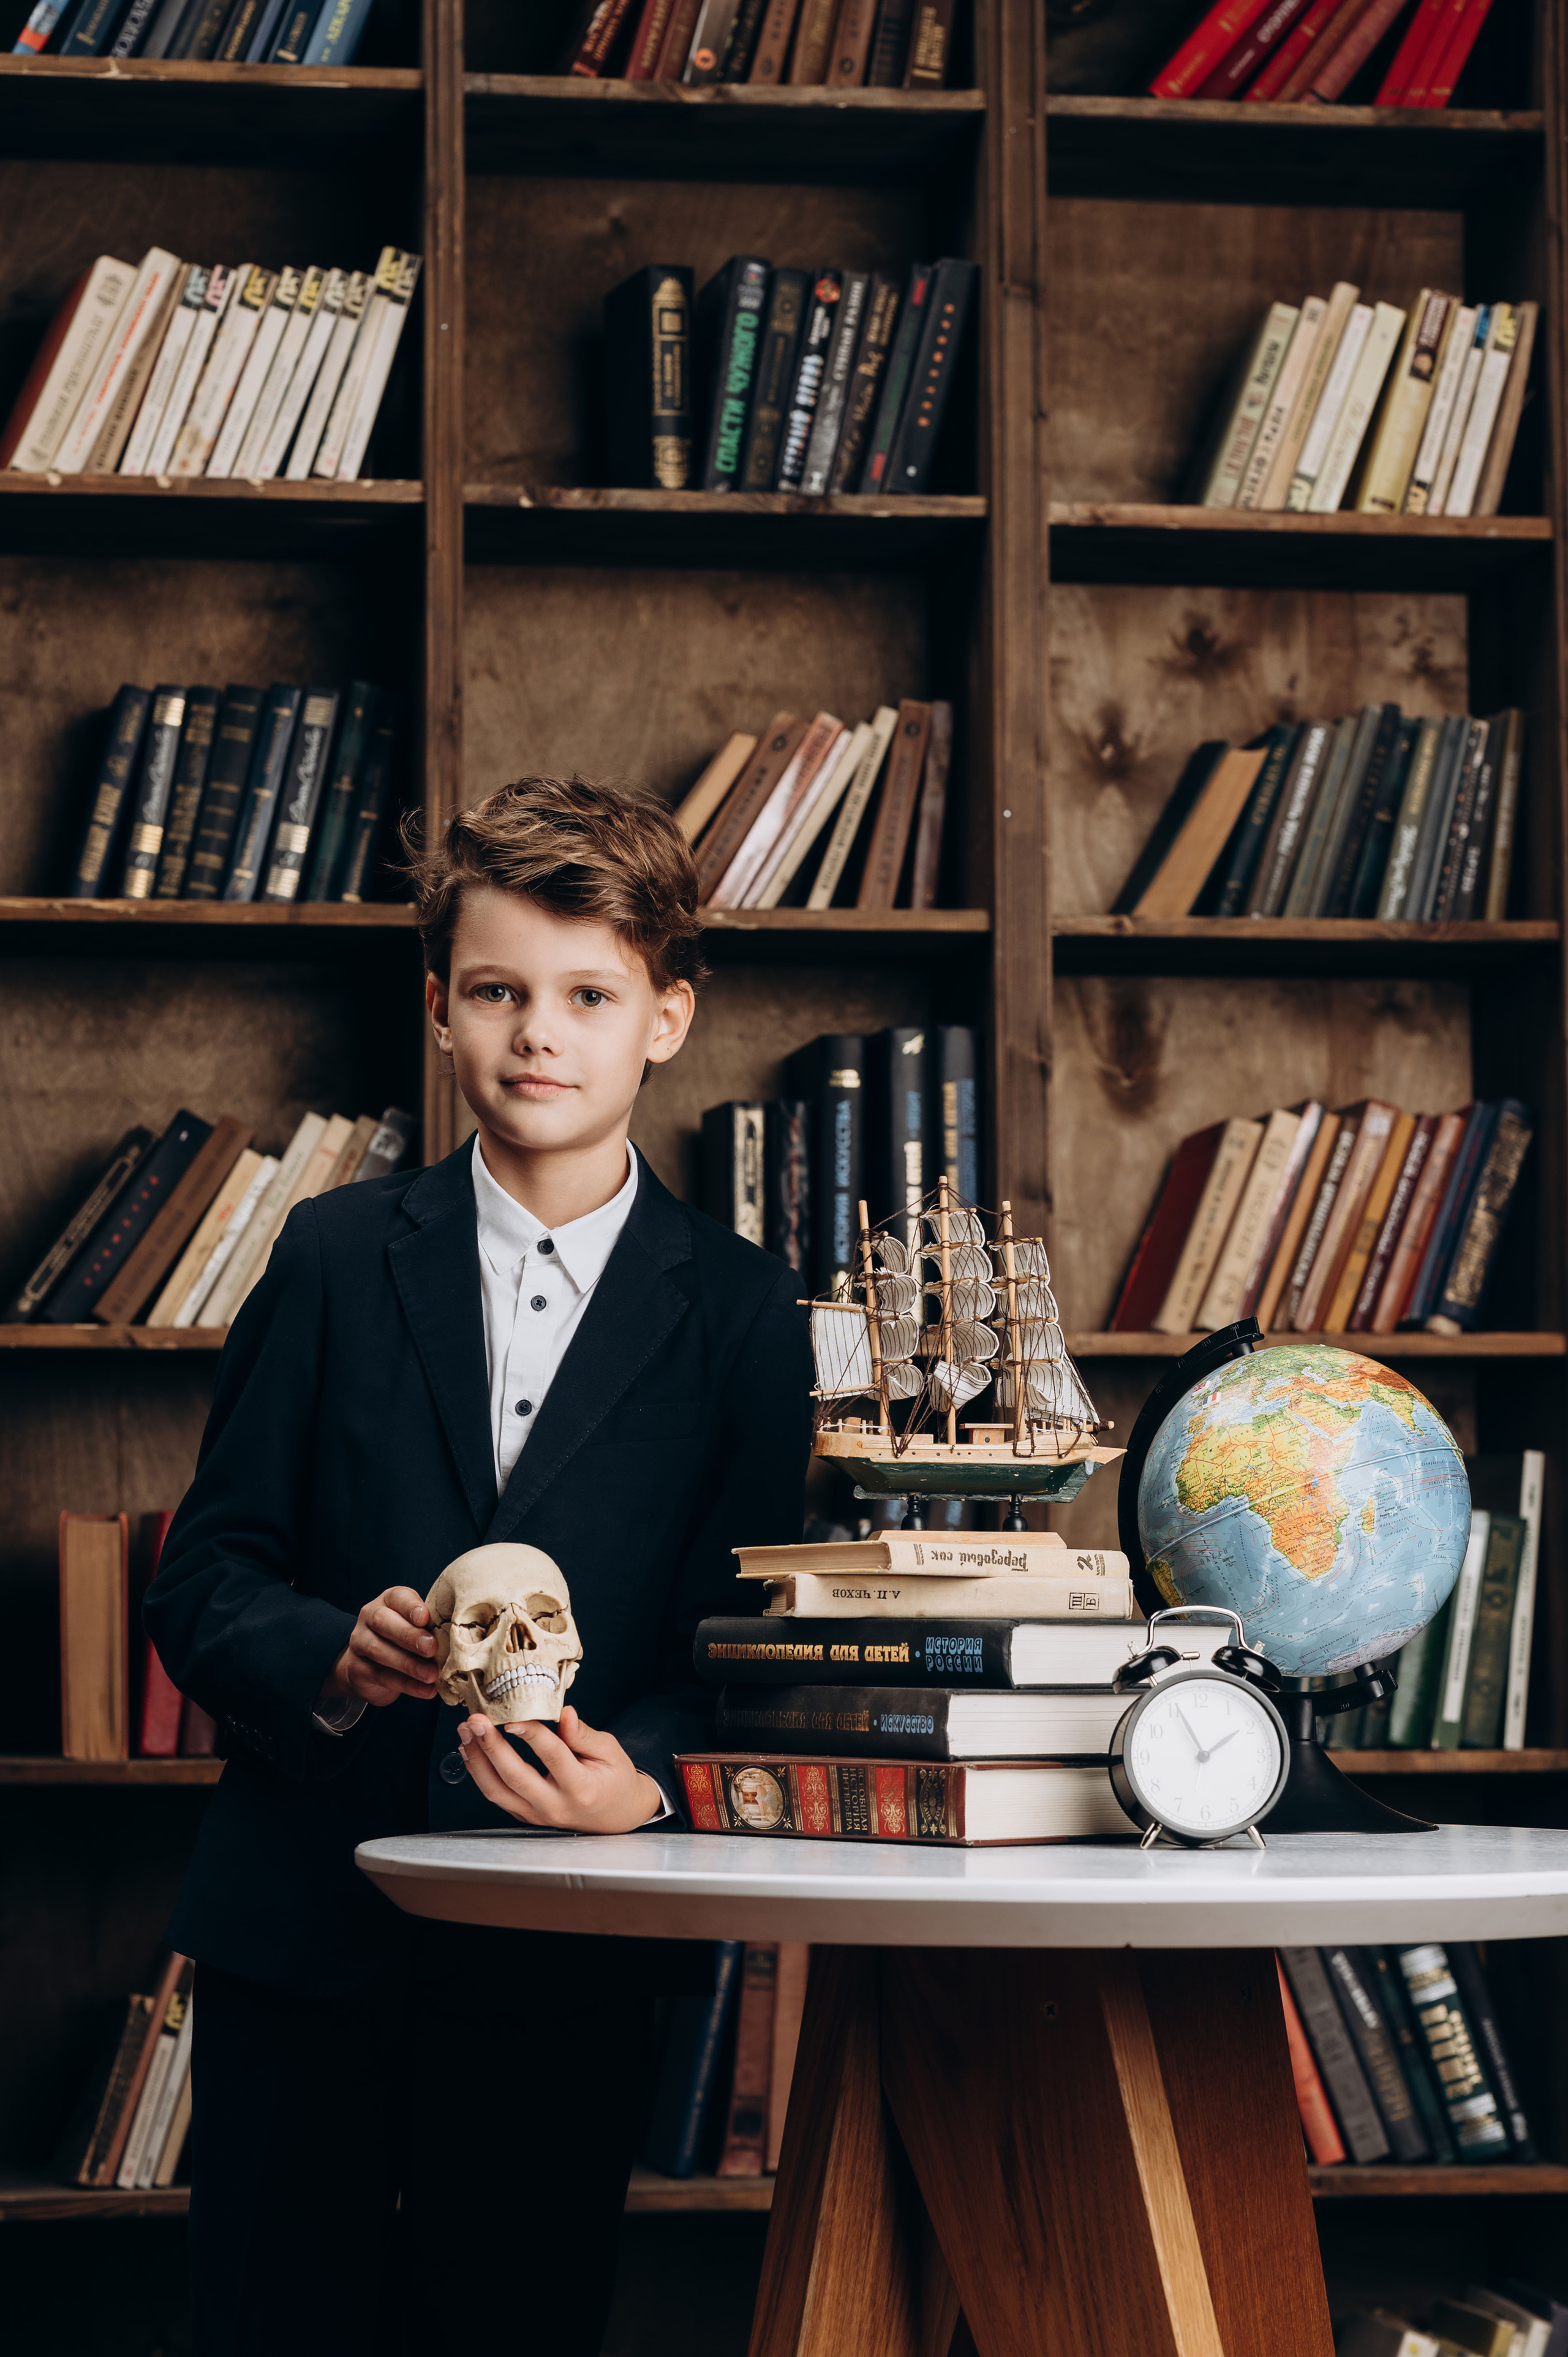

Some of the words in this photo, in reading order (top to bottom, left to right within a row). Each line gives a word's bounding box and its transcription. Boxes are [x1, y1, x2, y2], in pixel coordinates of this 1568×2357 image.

[725, 311, 760, 394] ЧУЖОГО
[714, 398, 746, 473] СПАСТИ
[834, 1100, 851, 1187] ИСКУССТВА
[834, 1193, 851, 1264] ИСТОРИЯ
[832, 1589, 872, 1599] ЧЕХОВ
[707, 1643, 824, 1661] ЭНЦИКЛОПЕДИЯ
[829, 1644, 859, 1662] ДЛЯ
[864, 1642, 910, 1663] ДЕТЕЙ
[925, 1636, 983, 1655] ИСТОРИЯ
[925, 1655, 984, 1673] РОССИИ
[1194, 1693, 1208, 1708] 12
[1226, 1701, 1231, 1716] 1
[1167, 1703, 1182, 1718] 11
[722, 1709, 807, 1730] ЭНЦИКЛОПЕДИЯ
[811, 1711, 833, 1730] ДЛЯ
[835, 1709, 870, 1732] ДЕТЕЙ
[880, 1714, 935, 1735] ИСКУССТВО
[1246, 1719, 1255, 1735] 2
[1150, 1723, 1163, 1739] 10
[1140, 1750, 1150, 1765] 9
[1256, 1748, 1266, 1763] 3
[1150, 1777, 1161, 1793] 8
[1247, 1775, 1258, 1790] 4
[842, 1768, 853, 1831] ИНТЕРЬЕРА
[850, 1768, 861, 1831] ИСТОРИЯ
[858, 1768, 868, 1831] ВСЕОБЩАЯ
[1174, 1797, 1183, 1812] 7
[1230, 1797, 1238, 1813] 5
[1200, 1805, 1210, 1821] 6
